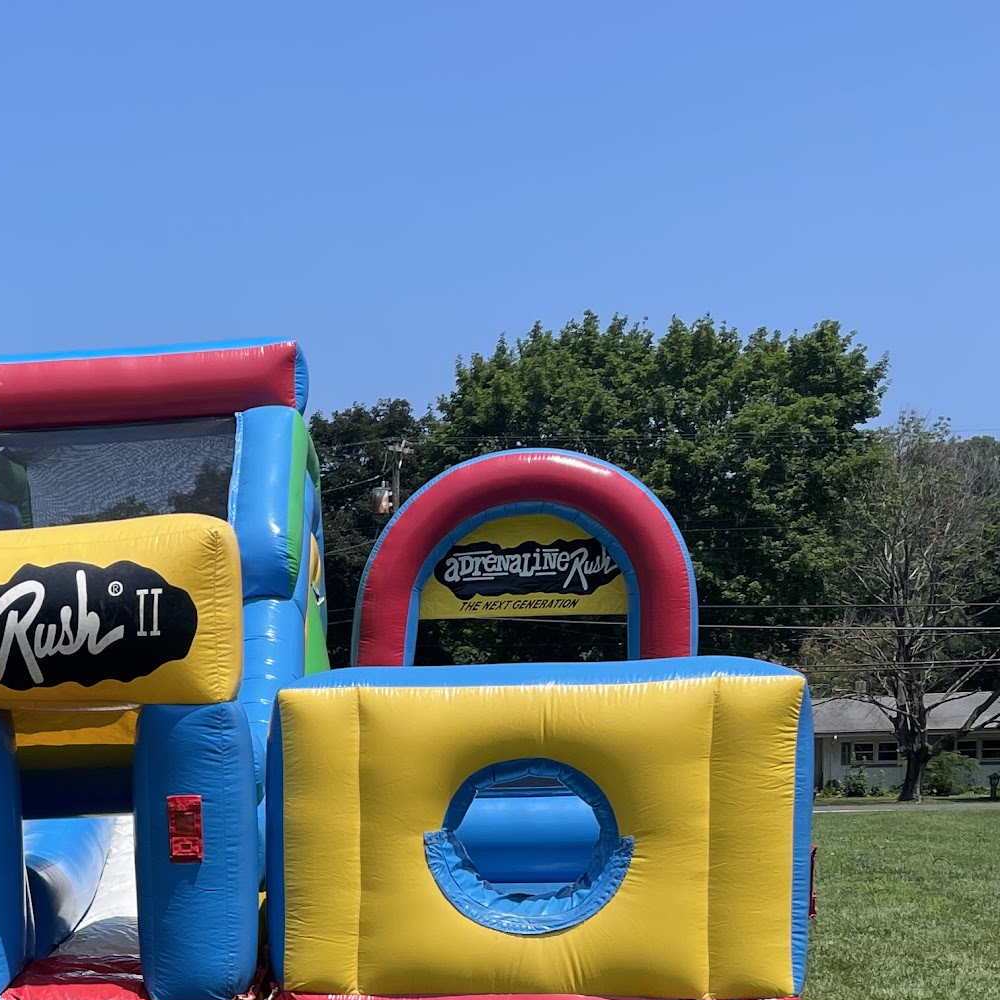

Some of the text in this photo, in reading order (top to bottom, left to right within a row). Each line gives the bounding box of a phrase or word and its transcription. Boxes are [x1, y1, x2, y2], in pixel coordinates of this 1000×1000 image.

[563, 545, 619, 591] Rush
[136, 588, 163, 636] II
[459, 598, 580, 611] THE NEXT GENERATION
